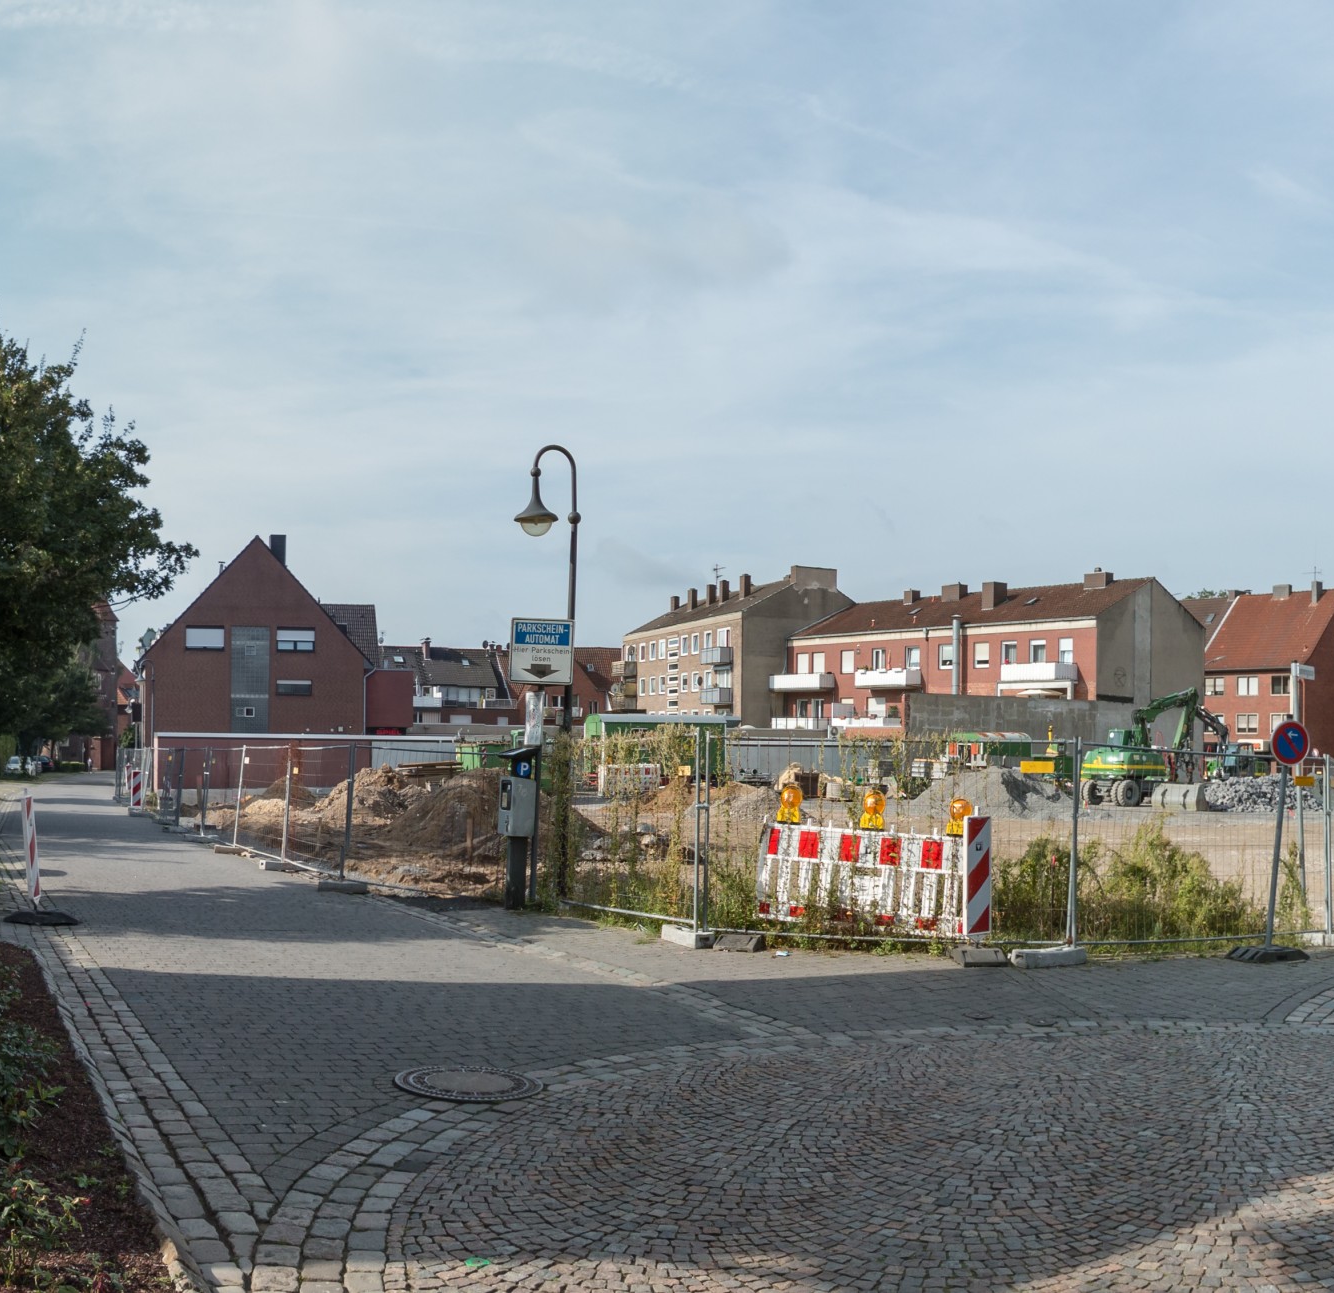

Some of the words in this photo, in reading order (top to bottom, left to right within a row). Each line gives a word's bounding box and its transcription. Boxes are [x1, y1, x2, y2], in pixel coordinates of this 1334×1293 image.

[517, 623, 568, 634] PARKSCHEIN-
[524, 634, 560, 645] AUTOMAT
[531, 646, 570, 655] Parkschein
[520, 763, 529, 776] P
